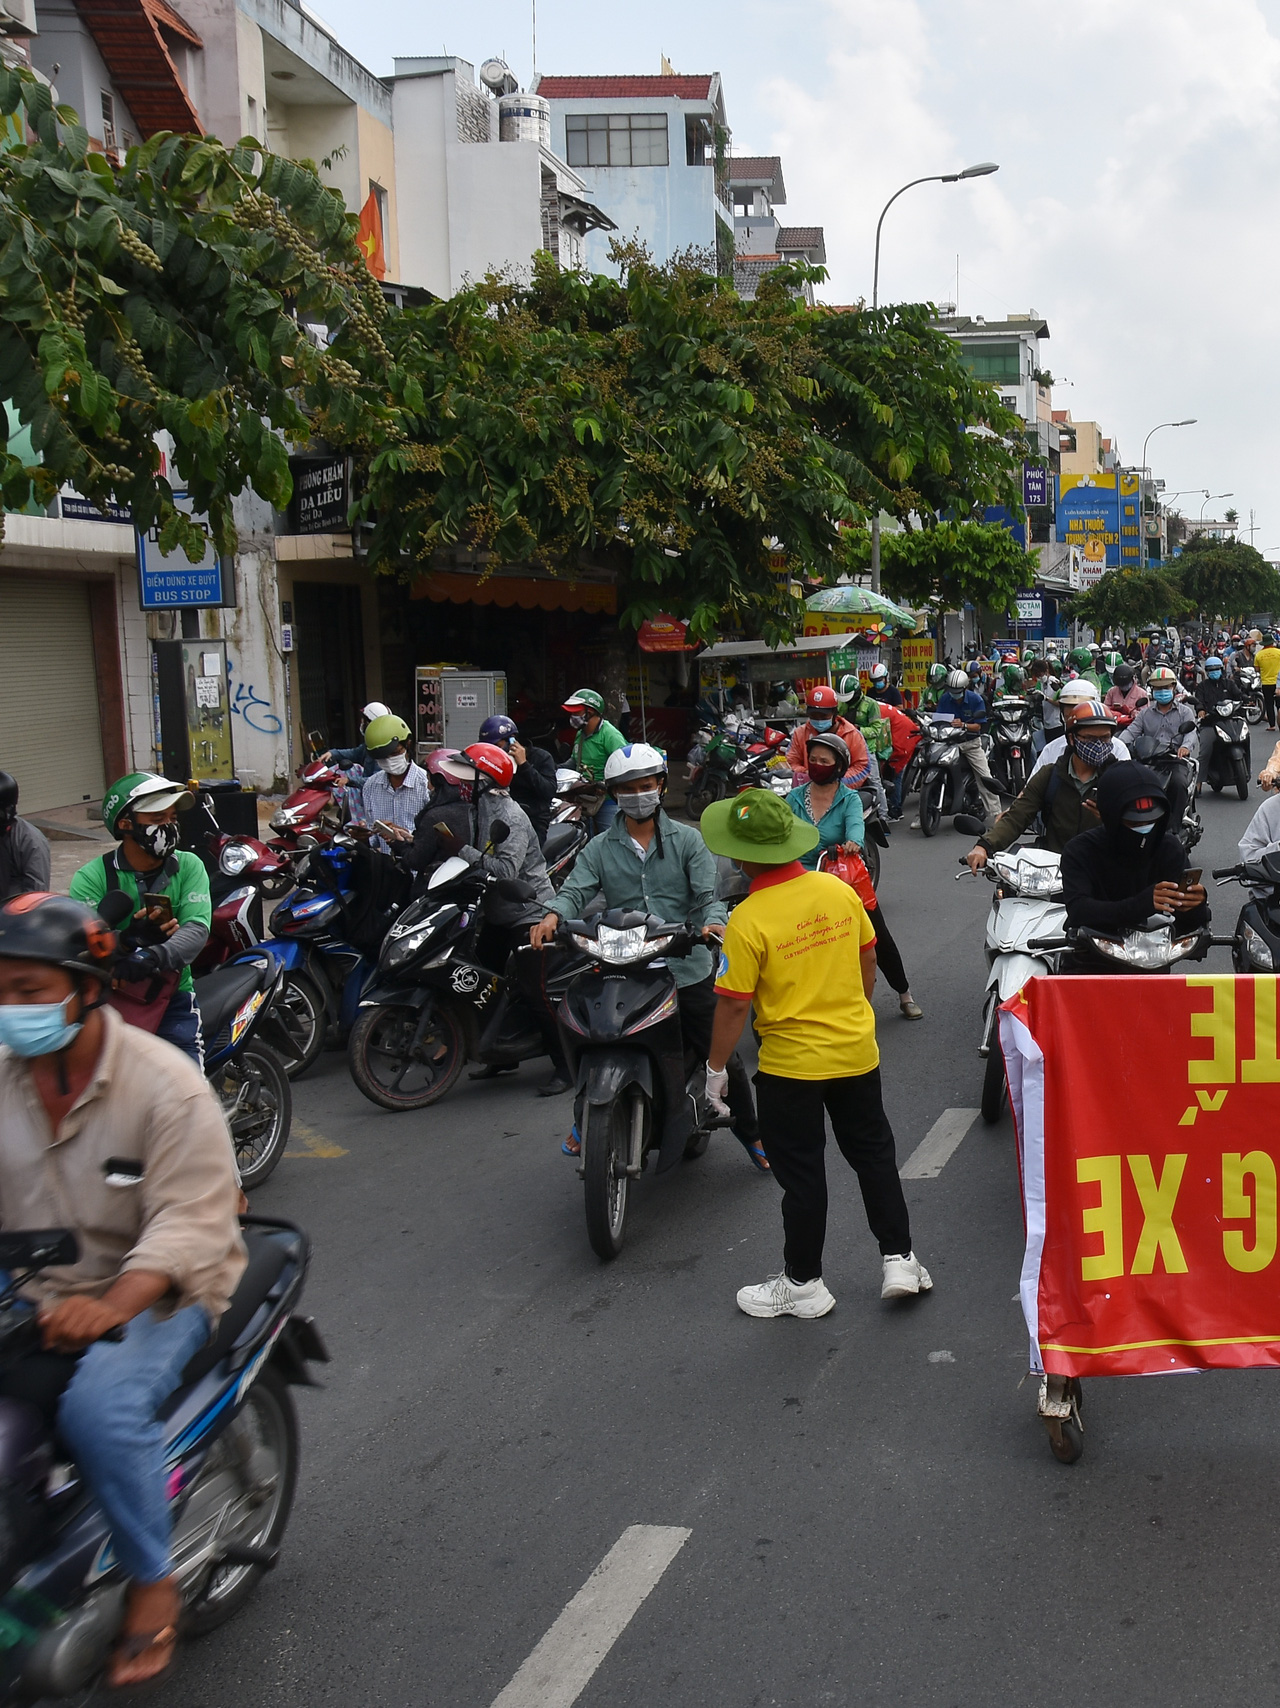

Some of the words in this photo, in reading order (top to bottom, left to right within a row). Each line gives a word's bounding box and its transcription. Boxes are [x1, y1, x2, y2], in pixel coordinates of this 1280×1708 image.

[323, 461, 344, 484] KHÁM
[1026, 470, 1044, 479] PHÚC
[1028, 481, 1042, 491] TÂM
[301, 496, 315, 511] DA
[317, 483, 342, 506] LIỄU
[1029, 495, 1041, 503] 175
[1070, 516, 1083, 531] NHÀ
[1114, 533, 1119, 544] 2
[1083, 566, 1102, 574] KHÁM
[146, 575, 164, 587] ĐIỂM
[166, 574, 186, 586] DỪNG
[188, 575, 197, 585] XE
[198, 574, 216, 585] BUÝT
[155, 591, 178, 602] BUS
[181, 590, 211, 600] STOP
[103, 794, 120, 819] Grab
[834, 916, 852, 930] 2019
[1077, 1154, 1188, 1281] XE
